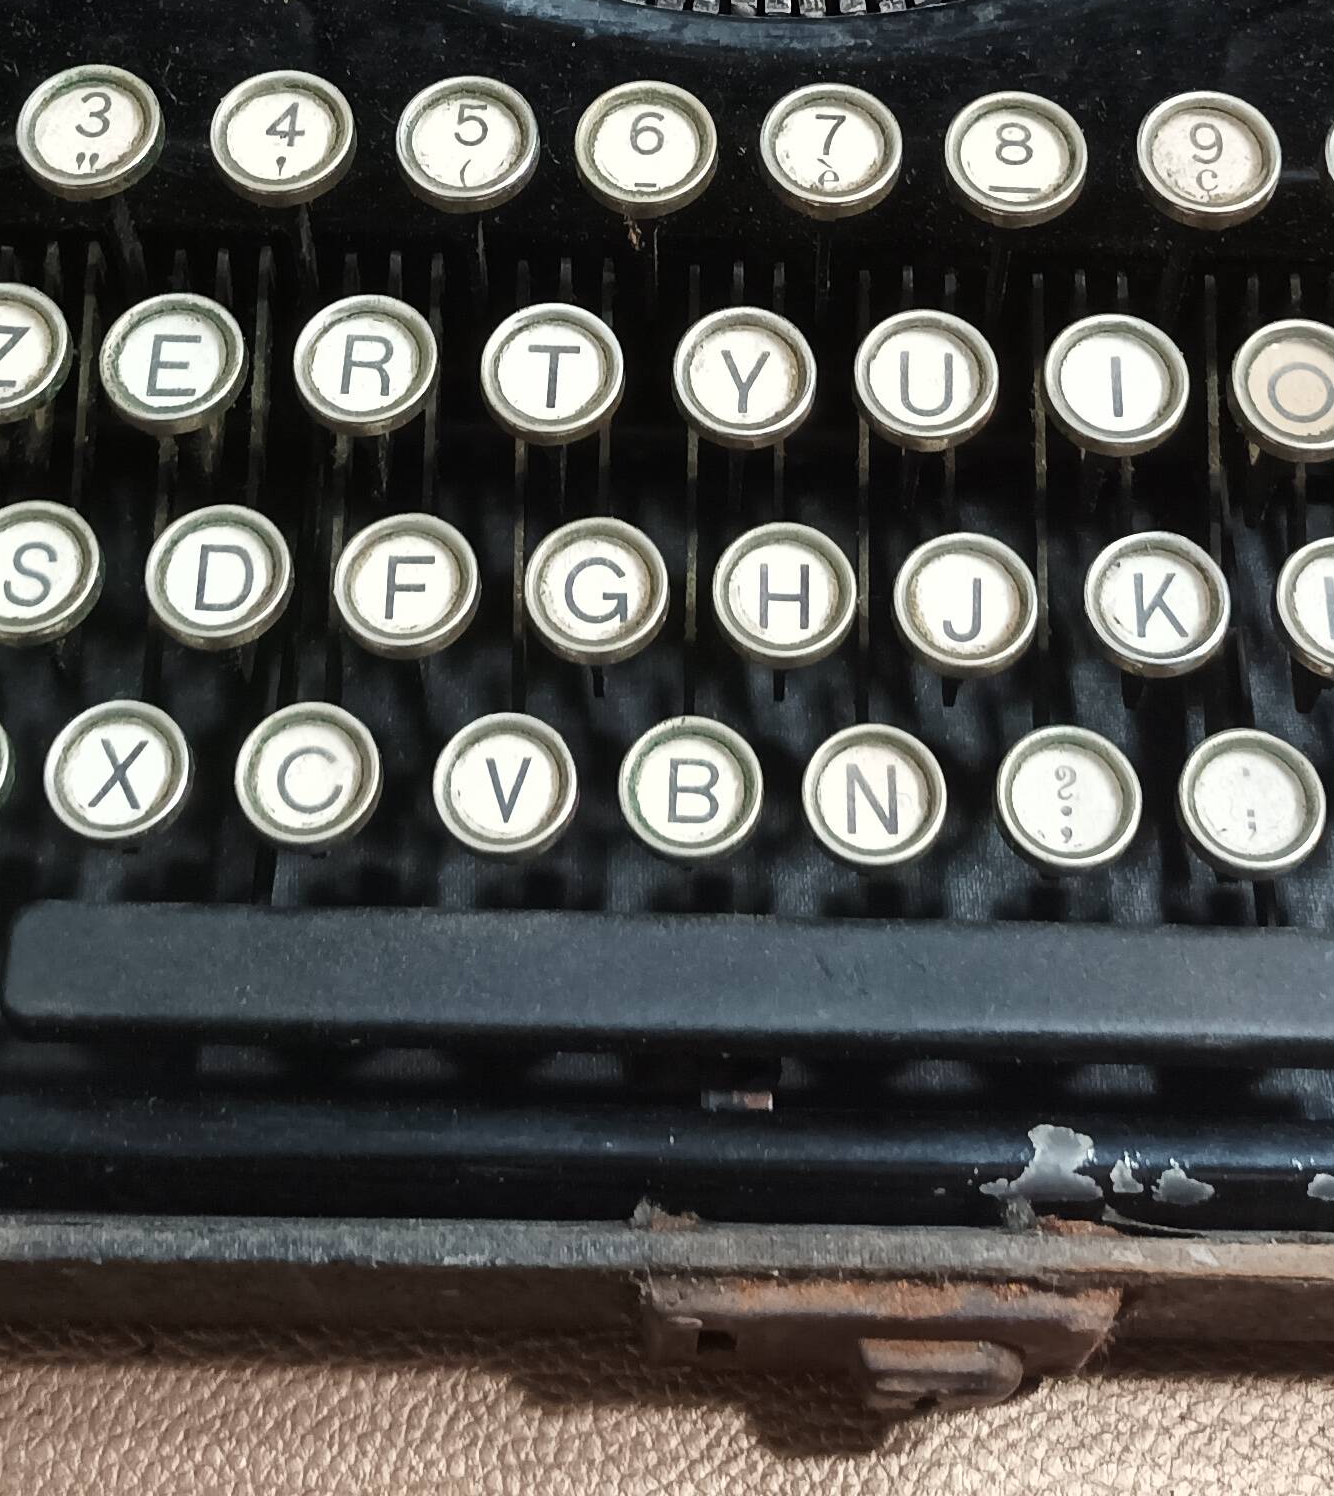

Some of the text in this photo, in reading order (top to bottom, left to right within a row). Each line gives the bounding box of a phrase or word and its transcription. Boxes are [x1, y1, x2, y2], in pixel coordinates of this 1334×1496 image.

[75, 91, 113, 139] 3
[265, 101, 306, 147] 4
[453, 104, 489, 147] 5
[629, 111, 665, 156] 6
[814, 113, 847, 156] 7
[995, 122, 1033, 166] 8
[1188, 121, 1224, 165] 9
[146, 333, 203, 397] E
[340, 334, 395, 397] R
[527, 344, 581, 409] T
[720, 349, 771, 414] Y
[899, 350, 954, 418] U
[1110, 356, 1124, 418] I
[3, 541, 58, 607] S
[194, 544, 255, 612] D
[384, 555, 436, 621] F
[564, 556, 628, 624] G
[759, 563, 810, 630] H
[1133, 572, 1189, 638] K
[942, 577, 982, 643] J
[87, 738, 149, 810] X
[276, 745, 343, 815] C
[485, 756, 532, 824] V
[668, 757, 720, 824] B
[846, 762, 899, 836] N
